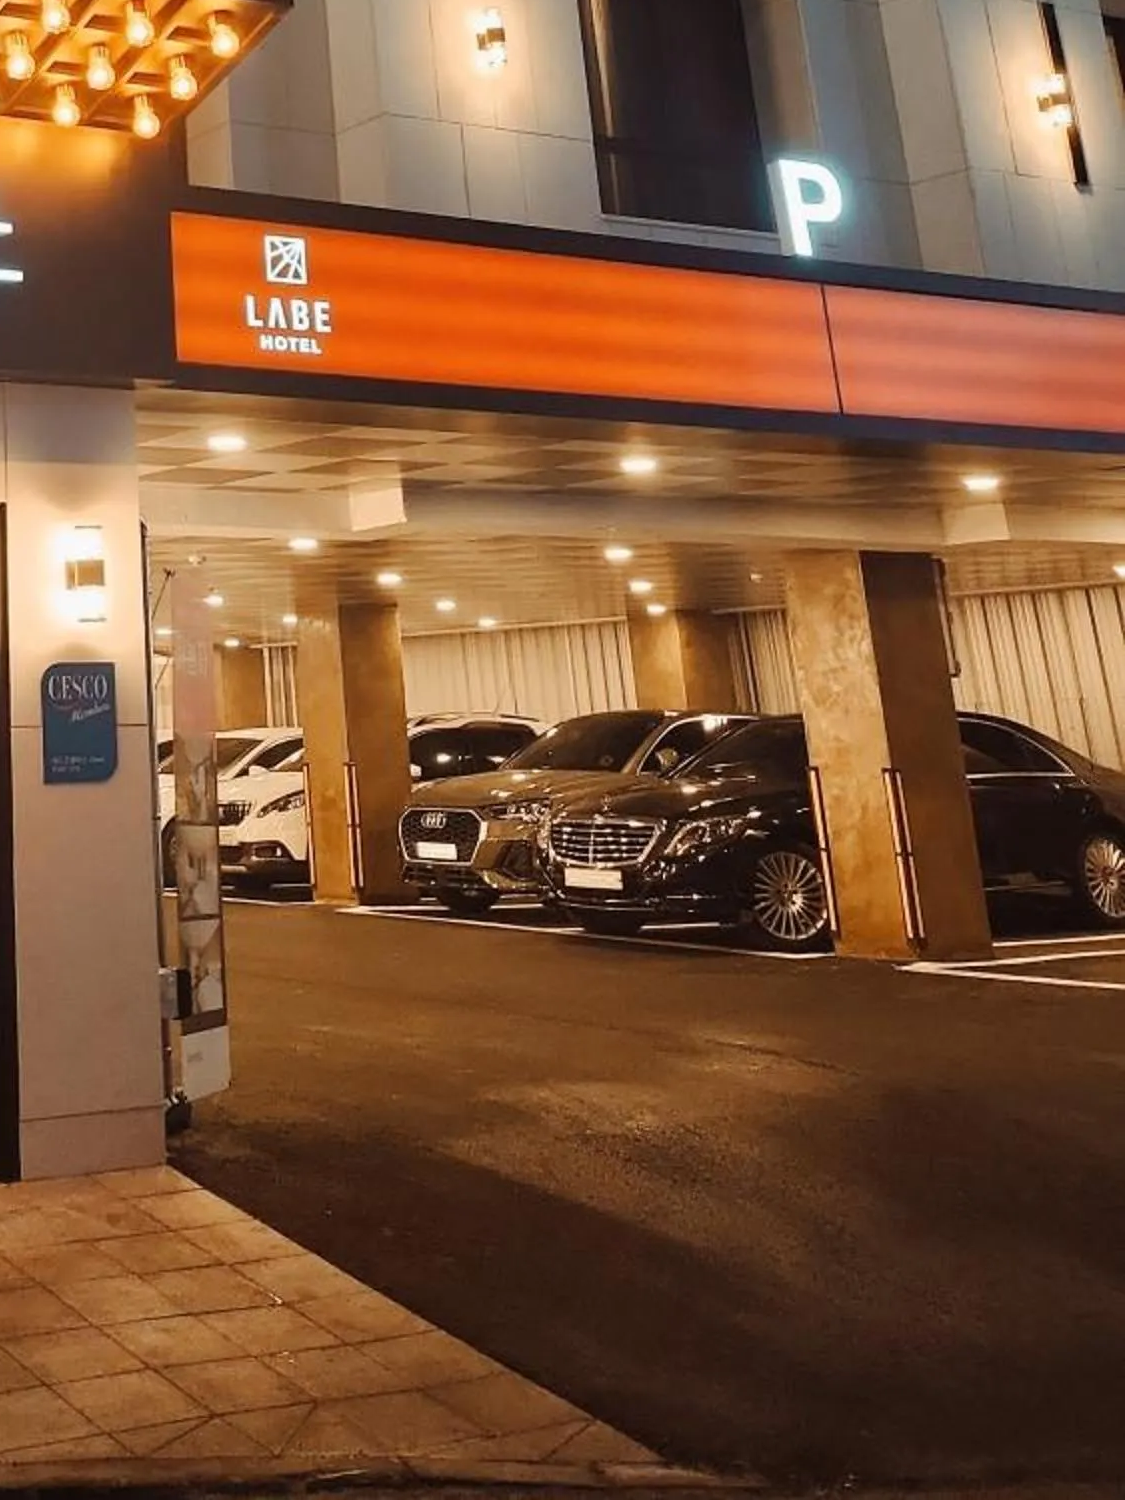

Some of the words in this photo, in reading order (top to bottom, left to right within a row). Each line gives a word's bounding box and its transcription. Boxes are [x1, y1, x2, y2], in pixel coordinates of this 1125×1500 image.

[767, 159, 842, 257] P
[245, 294, 332, 333] LABE
[259, 334, 323, 355] HOTEL
[47, 674, 108, 700] CESCO
